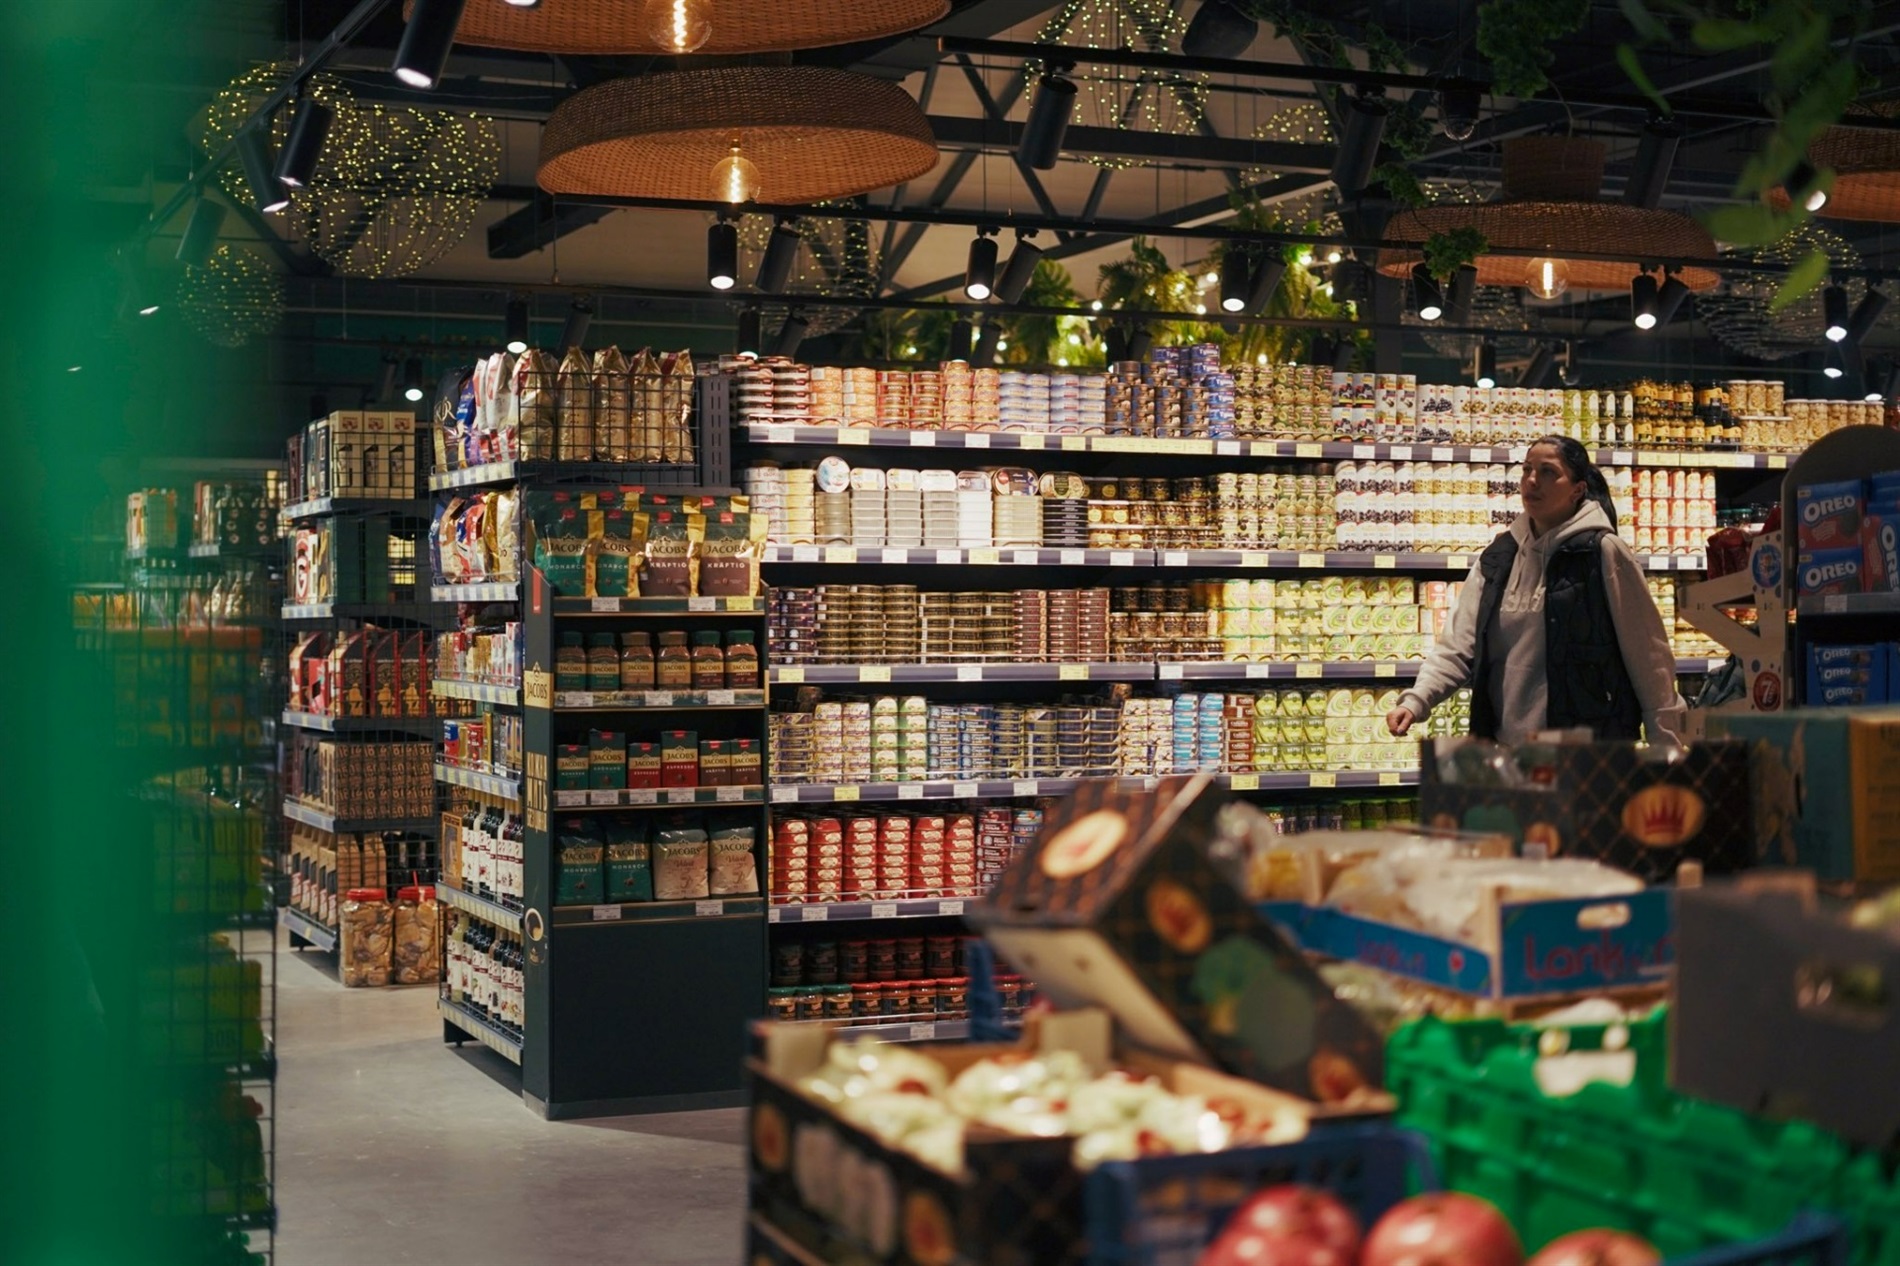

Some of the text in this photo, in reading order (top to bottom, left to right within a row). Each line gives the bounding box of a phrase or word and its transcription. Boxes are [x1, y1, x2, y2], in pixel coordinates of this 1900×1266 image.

[1803, 495, 1856, 523] OREO
[706, 544, 747, 554] JACOBS
[1805, 561, 1857, 588] OREO
[1823, 648, 1851, 661] OREO
[1824, 667, 1852, 680] OREO
[526, 681, 548, 700] JACOBS
[1826, 687, 1853, 700] OREO
[593, 753, 622, 762] JACOBS
[666, 752, 696, 761] JACOBS
[668, 846, 701, 857] JACOBS
